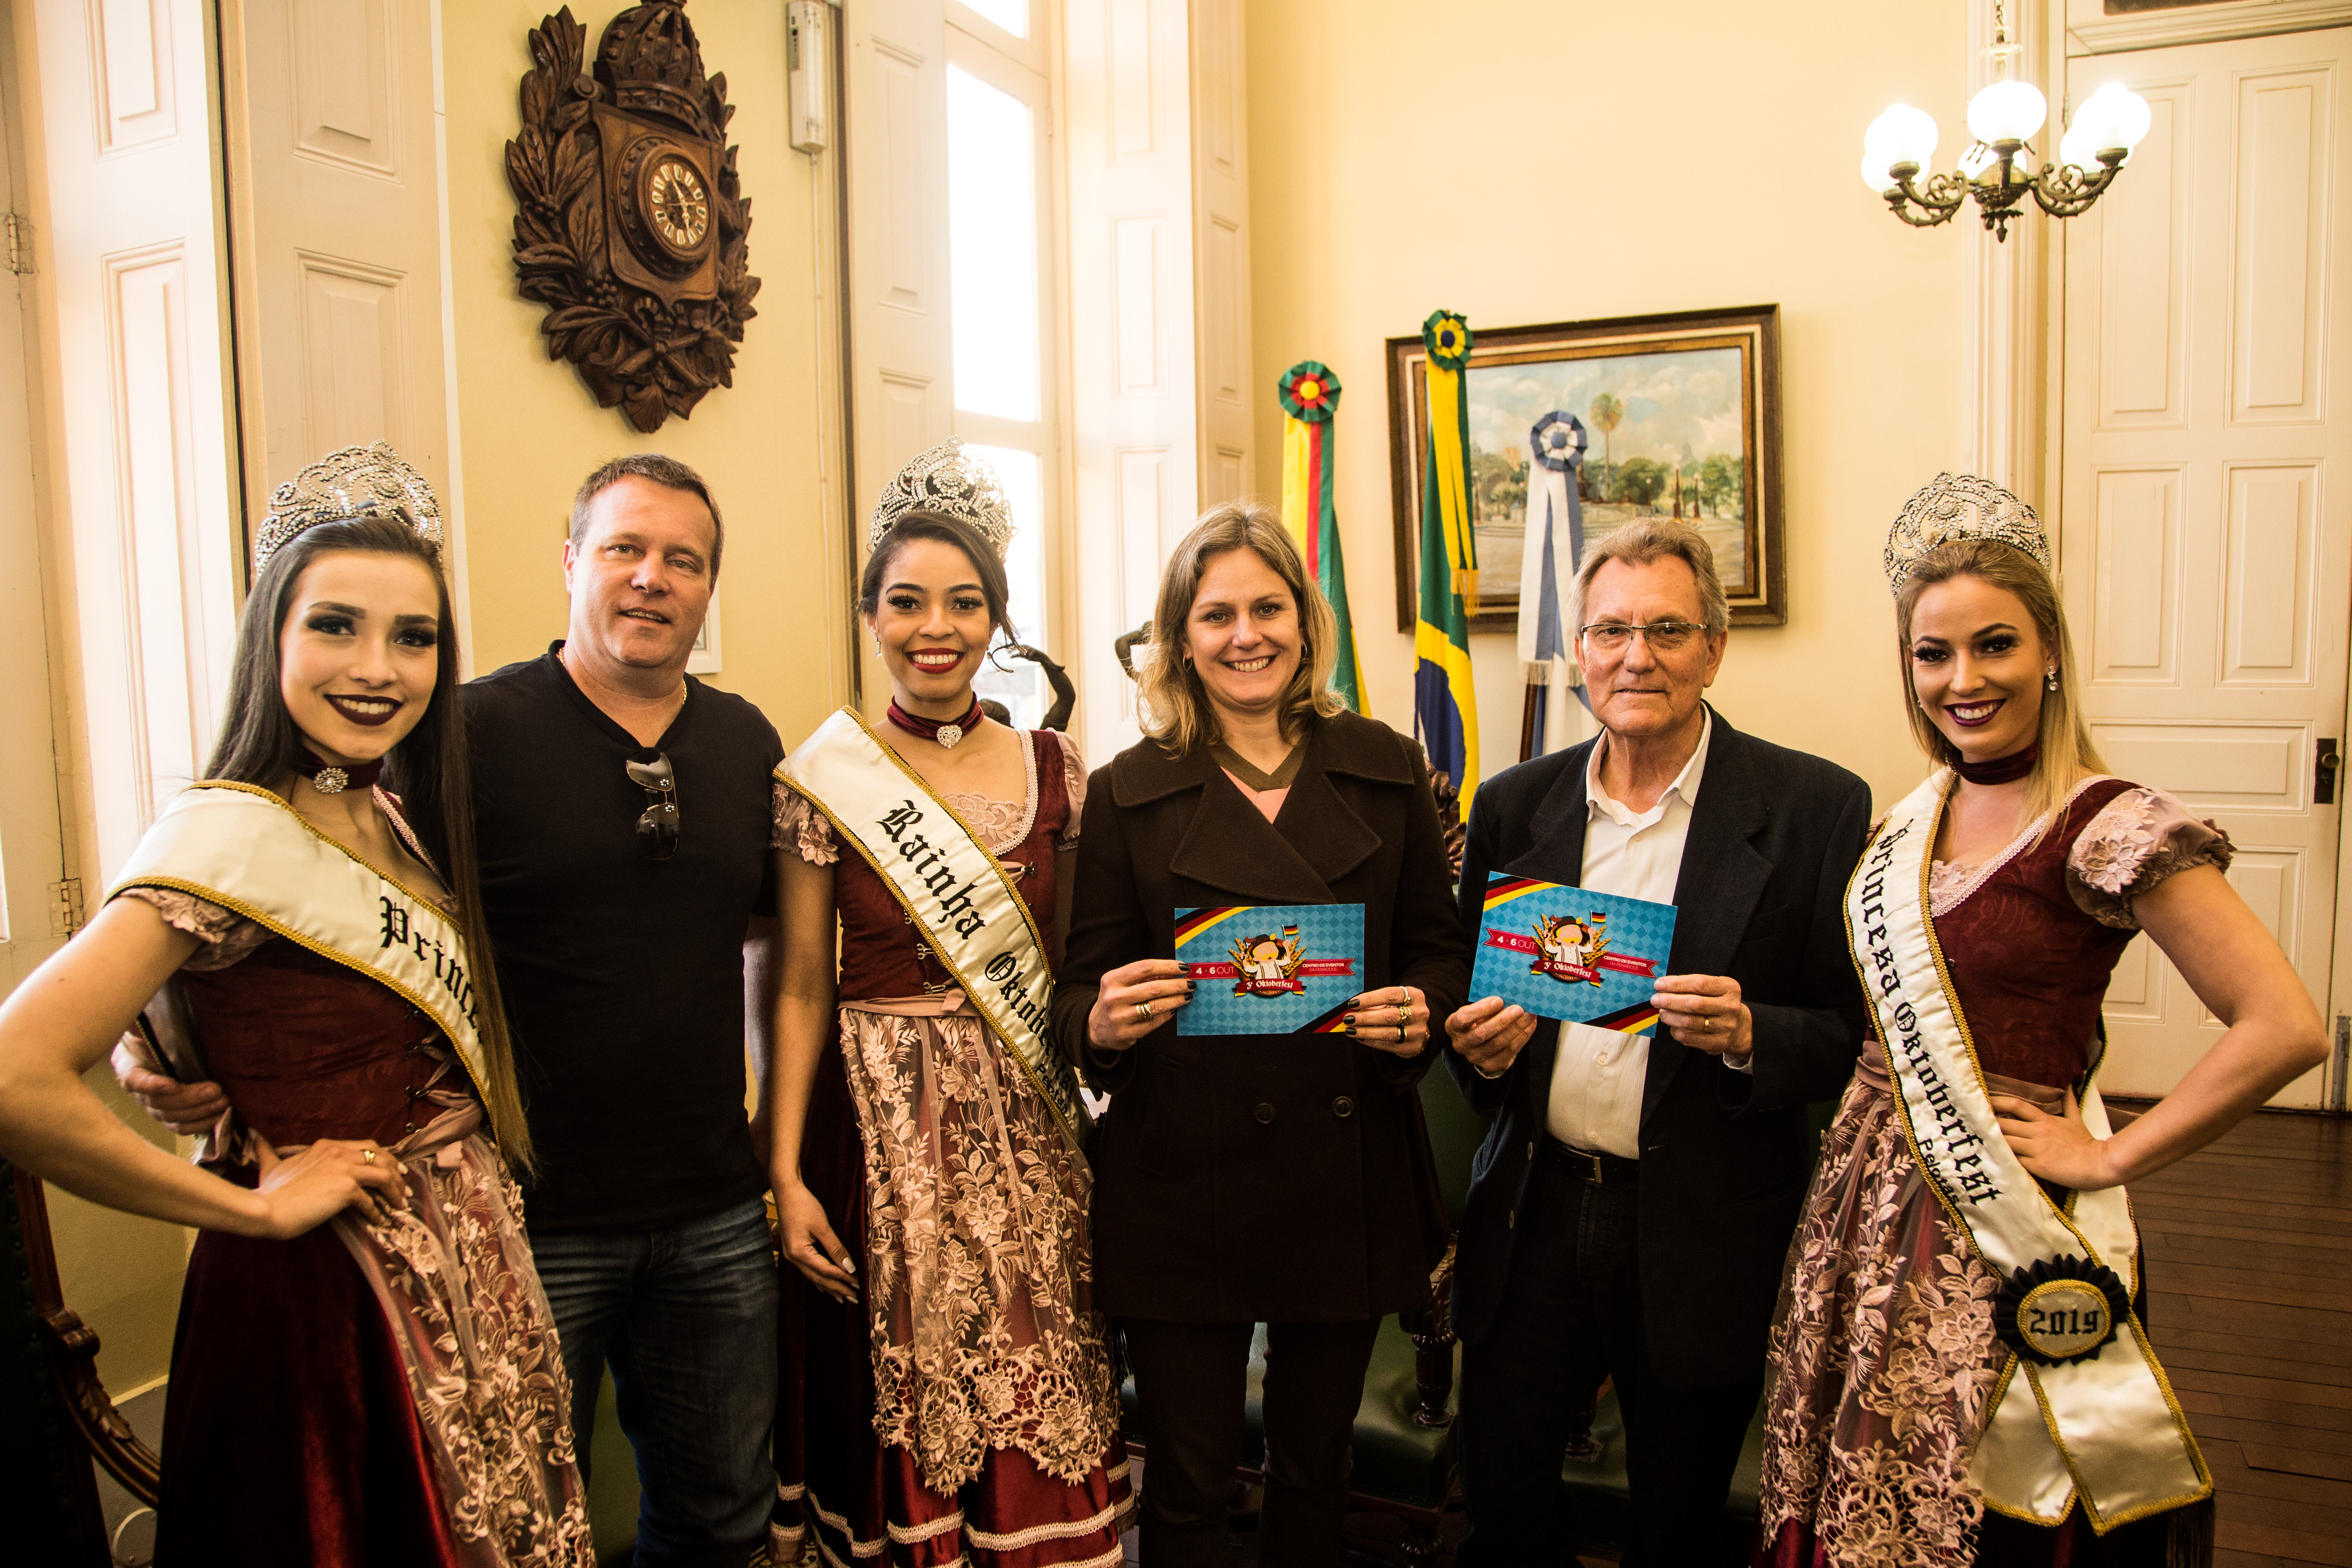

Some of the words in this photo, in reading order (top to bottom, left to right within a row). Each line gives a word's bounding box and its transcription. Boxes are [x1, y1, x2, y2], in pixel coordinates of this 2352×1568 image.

[876, 799, 986, 940] Rainha
[380, 896, 482, 1044] Prince
[1518, 940, 1536, 950] OUT
[1256, 980, 1293, 988] Oktoberfest
[1554, 963, 1592, 978] Oktoberfest
[1861, 818, 1914, 998] Princesa
[1894, 1001, 2003, 1206] Oktoberfest
[1034, 1063, 1068, 1113] Pelotas
[1919, 1138, 1960, 1203] Pelotas
[2030, 1308, 2099, 1335] 2019
